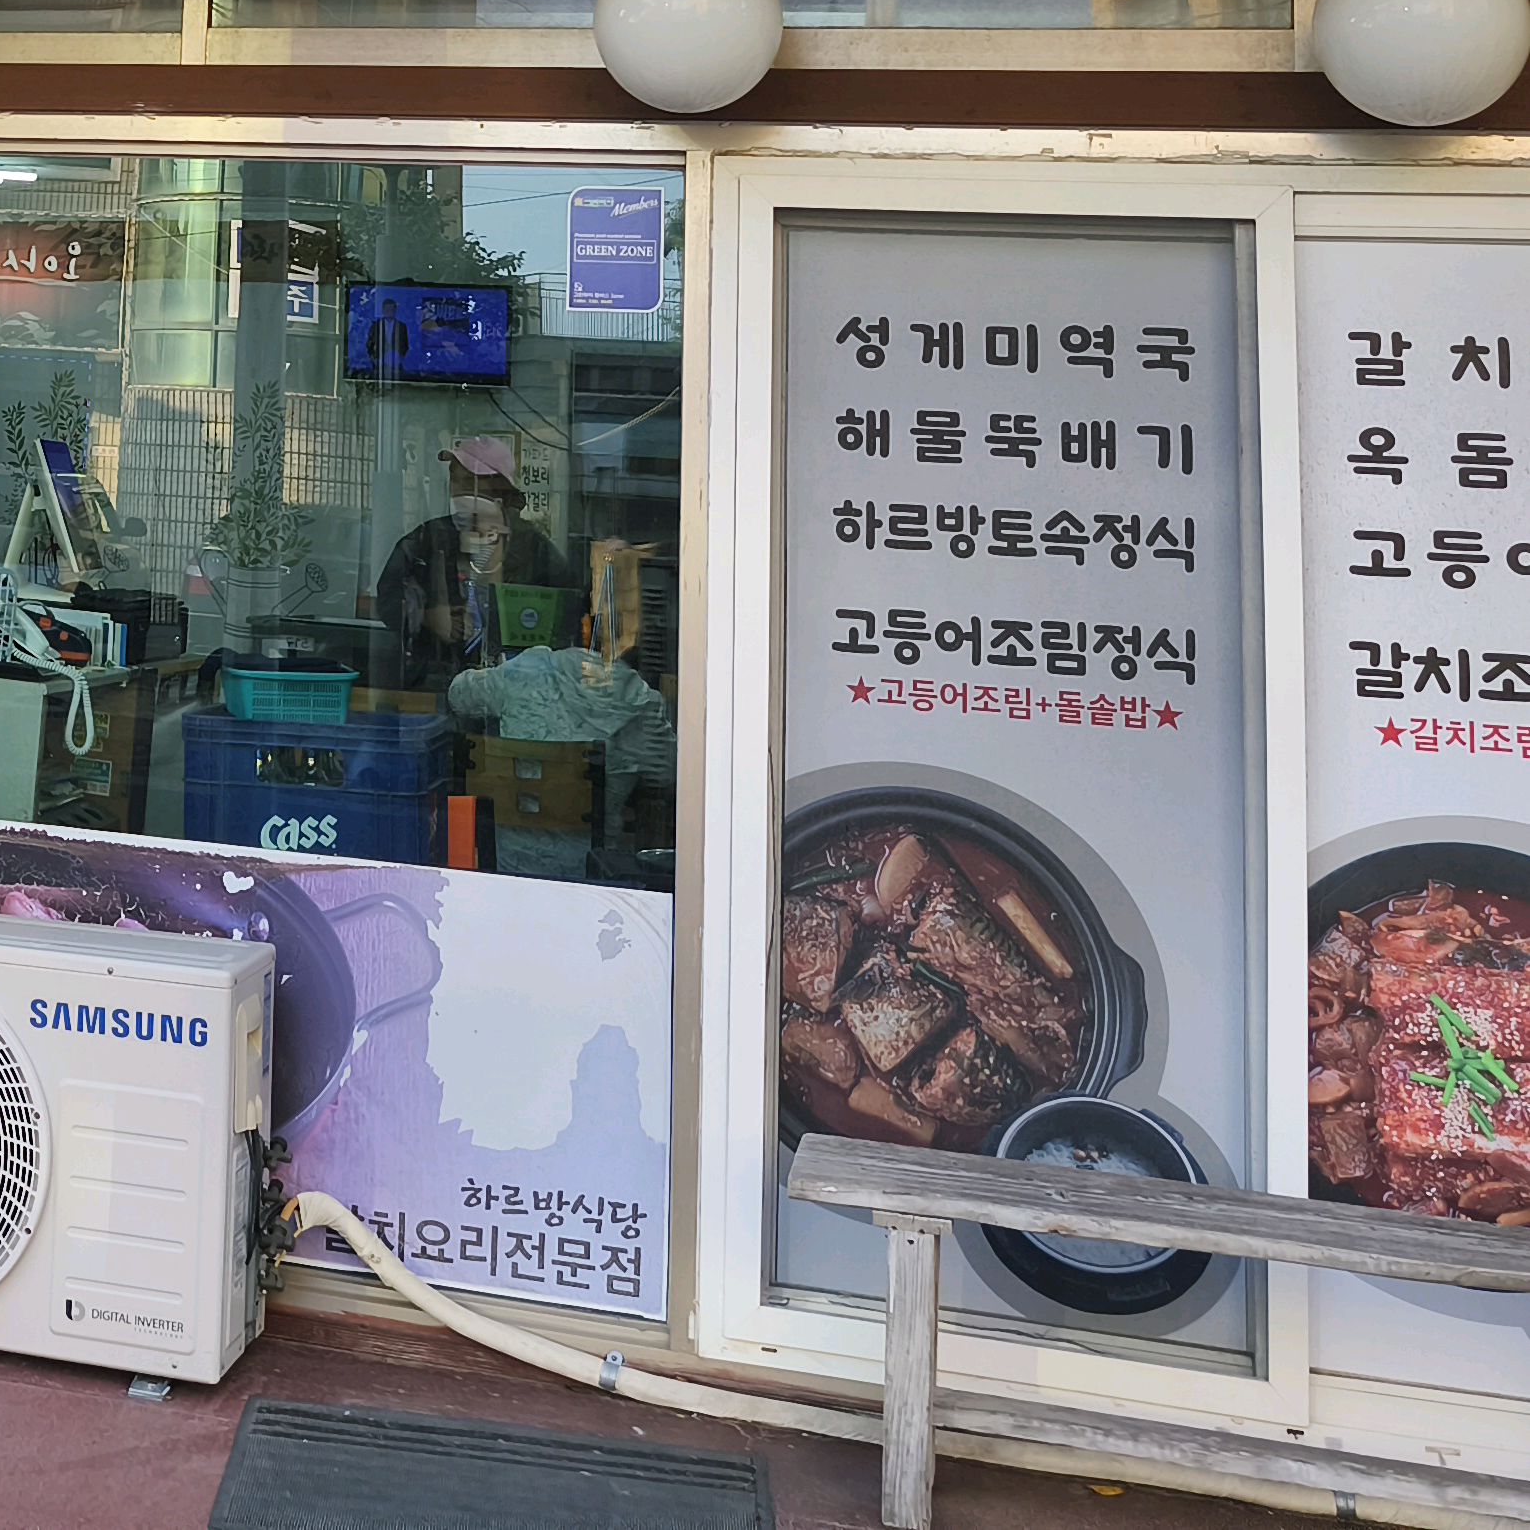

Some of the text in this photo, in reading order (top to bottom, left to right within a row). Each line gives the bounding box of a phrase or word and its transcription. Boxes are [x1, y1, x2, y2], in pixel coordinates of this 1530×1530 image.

[576, 244, 654, 257] GREEN ZONE
[835, 315, 1197, 383] 성게미역국
[834, 407, 1196, 476] 해물뚝배기
[831, 498, 1197, 574] 하르방토속정식
[830, 607, 1197, 686] 고등어조림정식
[29, 998, 209, 1048] SAMSUNG
[460, 1178, 648, 1240] 하르방식당
[91, 1308, 184, 1333] DIGITAL INVERTER
